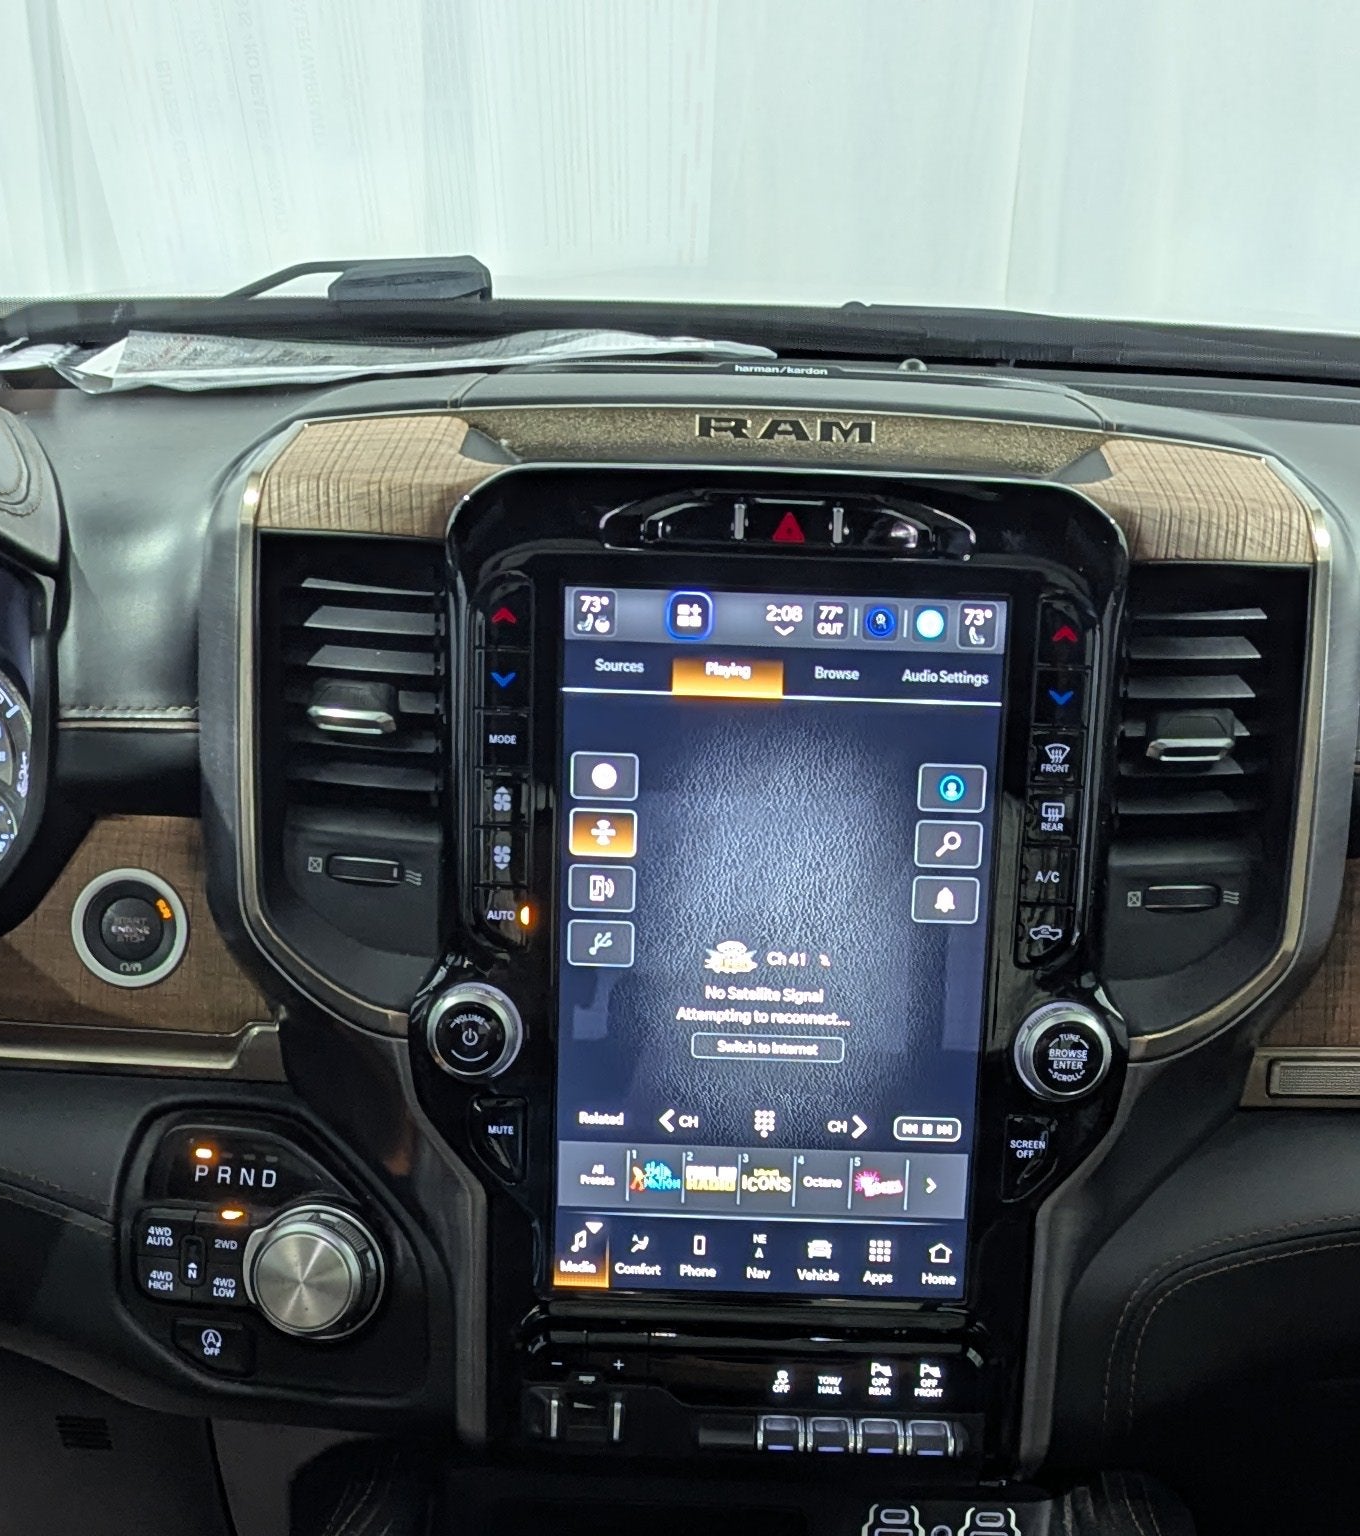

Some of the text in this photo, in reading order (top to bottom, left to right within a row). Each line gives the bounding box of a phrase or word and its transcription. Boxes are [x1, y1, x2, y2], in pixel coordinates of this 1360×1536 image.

[735, 364, 828, 376] harman/kardon
[696, 414, 876, 444] RAM
[817, 622, 844, 636] OUT
[595, 659, 644, 674] Sources
[705, 661, 752, 679] Playing
[814, 666, 860, 681] Browse
[902, 669, 989, 688] Audio Settings
[489, 734, 517, 745] MODE
[1041, 764, 1070, 773] FRONT
[1041, 822, 1064, 831] REAR
[1034, 871, 1060, 883] A/C
[487, 910, 516, 921] AUTO
[766, 952, 788, 967] Ch
[789, 953, 806, 968] 41
[704, 986, 824, 1004] No Satellite Signal
[453, 1014, 487, 1025] VOLUME
[675, 1007, 751, 1026] Attempting
[753, 1010, 769, 1023] to
[1059, 1032, 1081, 1042] TUNE
[716, 1039, 819, 1056] Switch to Internet
[1049, 1048, 1088, 1059] BROWSE
[1053, 1060, 1084, 1070] ENTER
[1052, 1071, 1082, 1083] SCROLL
[578, 1111, 624, 1127] Related
[678, 1115, 699, 1128] CH
[488, 1125, 514, 1135] MUTE
[827, 1120, 848, 1133] CH
[1010, 1139, 1046, 1150] SCREEN
[631, 1149, 637, 1160] 1
[686, 1151, 694, 1162] 2
[742, 1153, 750, 1164] 3
[797, 1155, 805, 1165] 4
[1016, 1150, 1034, 1159] OFF
[854, 1156, 861, 1167] 5
[194, 1165, 277, 1188] P R N D
[580, 1174, 616, 1186] Presets
[803, 1176, 842, 1188] Octane
[148, 1226, 172, 1238] 4WD
[146, 1235, 173, 1247] AUTO
[214, 1239, 238, 1250] 2WD
[752, 1234, 768, 1245] NE
[559, 1260, 596, 1274] Media
[615, 1263, 661, 1276] Comfort
[679, 1264, 716, 1279] Phone
[149, 1270, 173, 1281] 4WD
[188, 1268, 197, 1279] N
[746, 1267, 770, 1280] Nav
[797, 1269, 839, 1282] Vehicle
[863, 1271, 893, 1286] Apps
[213, 1277, 236, 1288] 4WD
[921, 1273, 956, 1286] Home
[148, 1280, 173, 1292] HIGH
[213, 1287, 235, 1298] LOW
[203, 1347, 220, 1356] OFF
[871, 1378, 889, 1386] OFF
[921, 1379, 938, 1387] OFF
[773, 1384, 790, 1393] OFF
[818, 1386, 841, 1395] HAUL
[869, 1387, 891, 1396] REAR
[915, 1388, 943, 1397] FRONT
